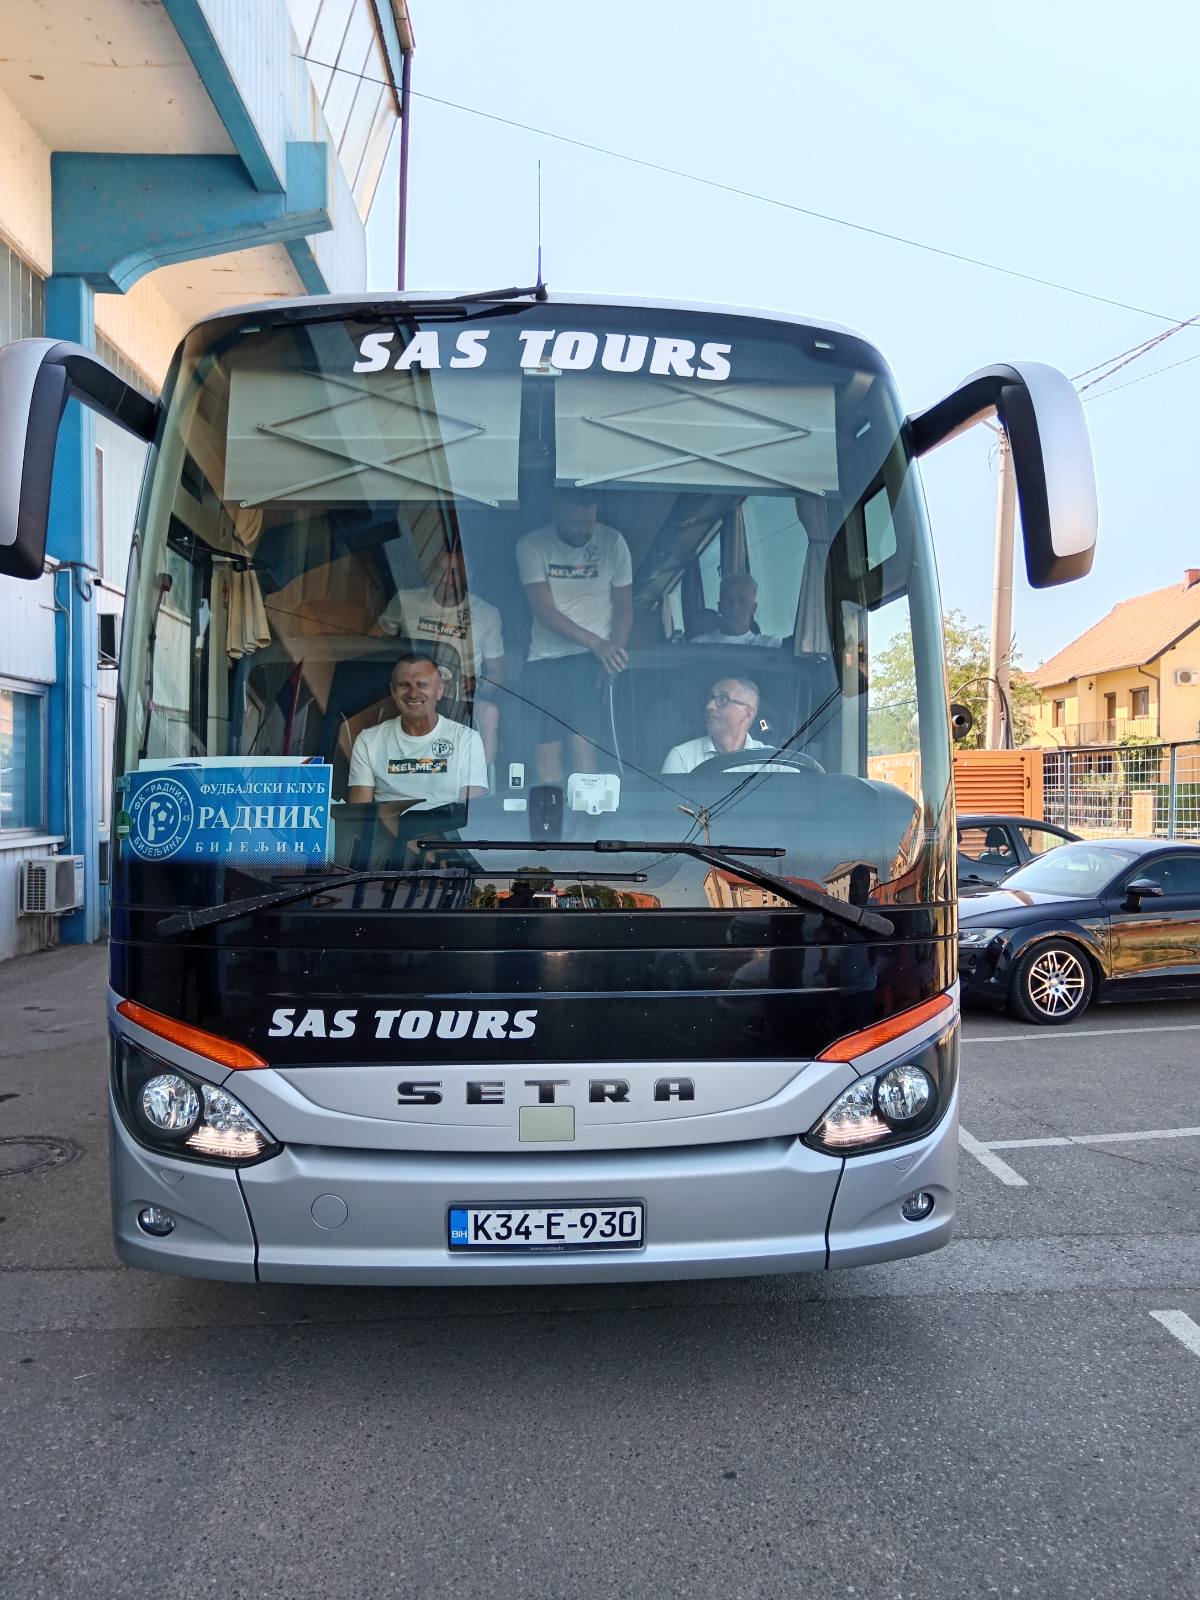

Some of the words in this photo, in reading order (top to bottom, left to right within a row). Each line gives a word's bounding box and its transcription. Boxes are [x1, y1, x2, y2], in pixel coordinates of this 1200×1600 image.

[352, 330, 490, 373] SAS
[519, 330, 732, 381] TOURS
[391, 762, 433, 772] KELME
[200, 783, 282, 797] ФУДБАЛСКИ
[286, 782, 325, 794] КЛУБ
[198, 805, 325, 834] РАДНИК
[134, 835, 182, 857] БИЈЕЉИНА
[195, 841, 322, 854] БИЈЕЉИНА
[268, 1008, 357, 1039] SAS
[374, 1009, 538, 1039] TOURS
[397, 1076, 696, 1105] SETRA
[451, 1230, 468, 1239] BIH
[473, 1210, 636, 1241] K34-E-930
